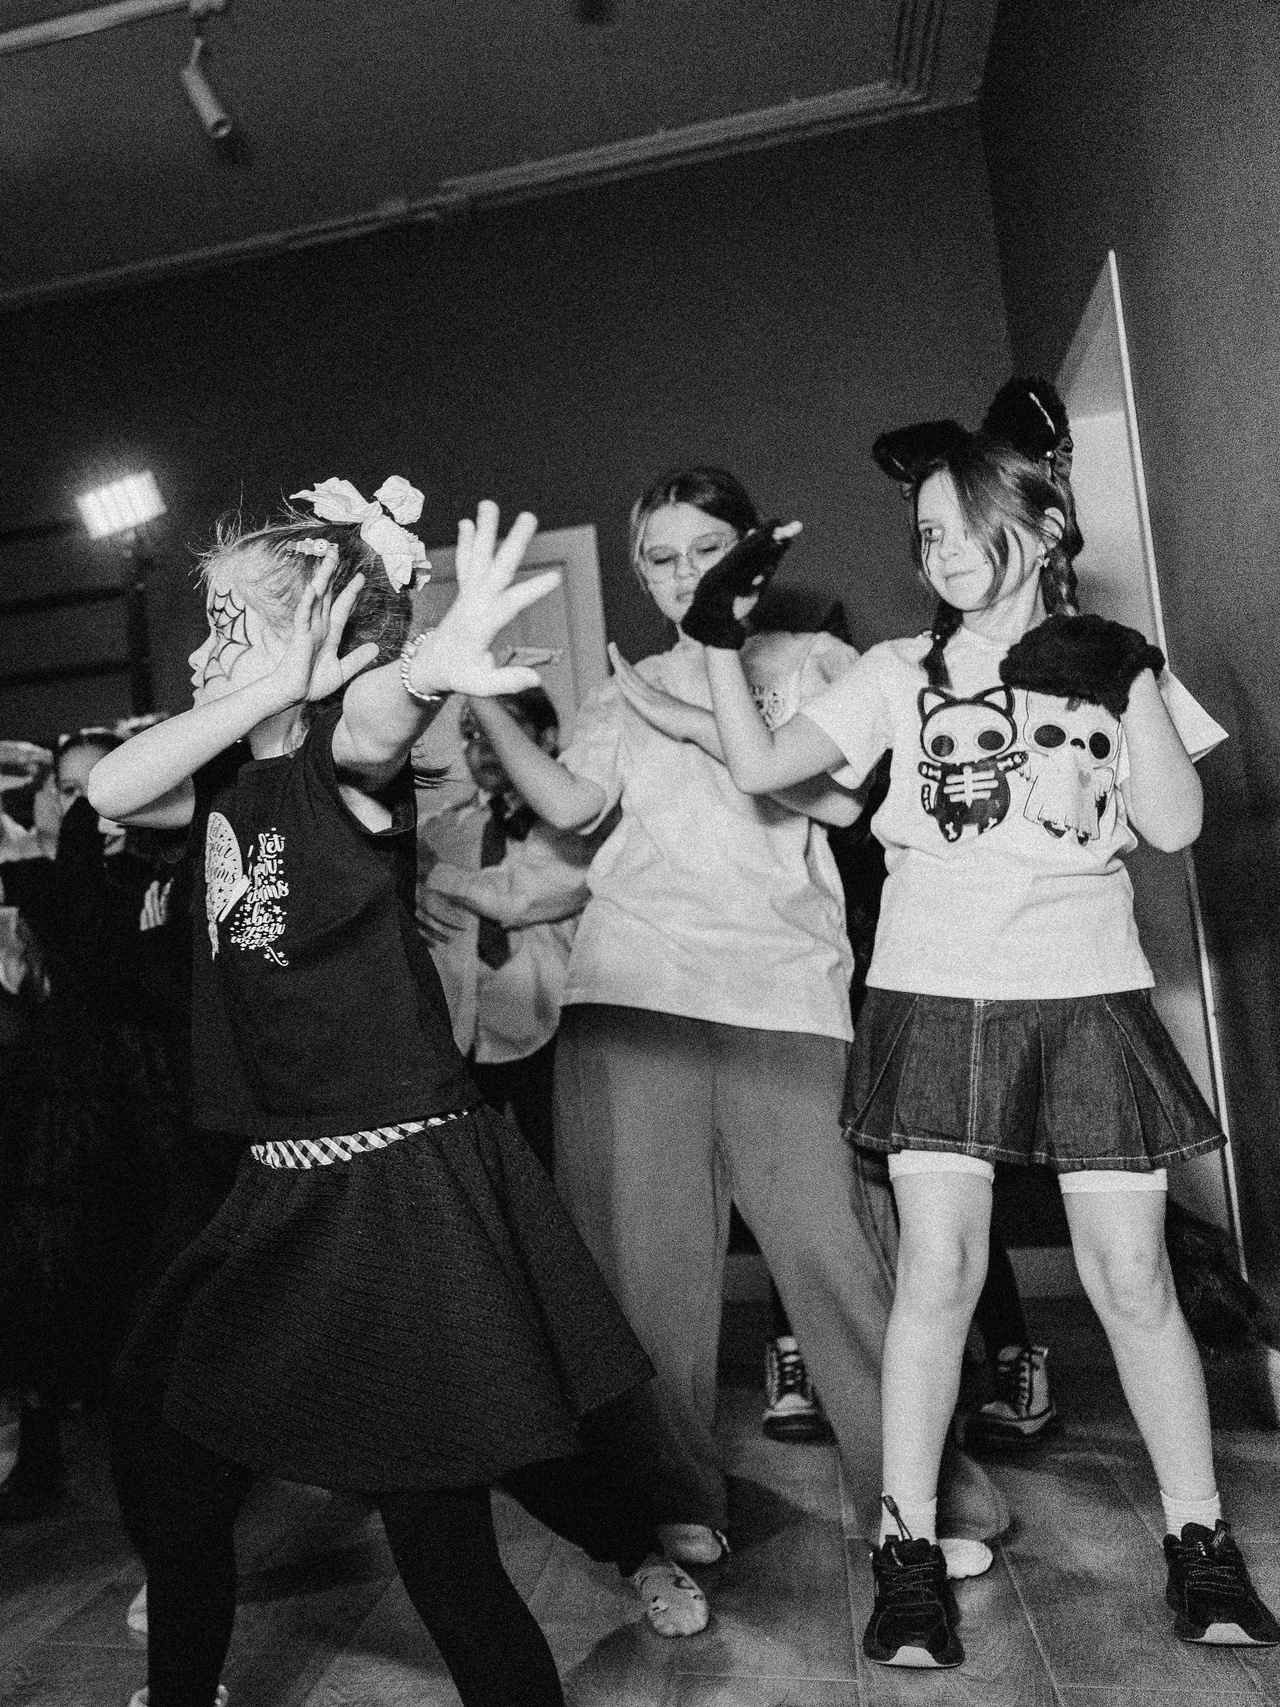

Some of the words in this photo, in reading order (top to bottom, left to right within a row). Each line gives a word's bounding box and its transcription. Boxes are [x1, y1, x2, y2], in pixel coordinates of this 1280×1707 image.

[258, 833, 285, 858] let
[252, 902, 274, 926] be
[242, 923, 286, 938] your
